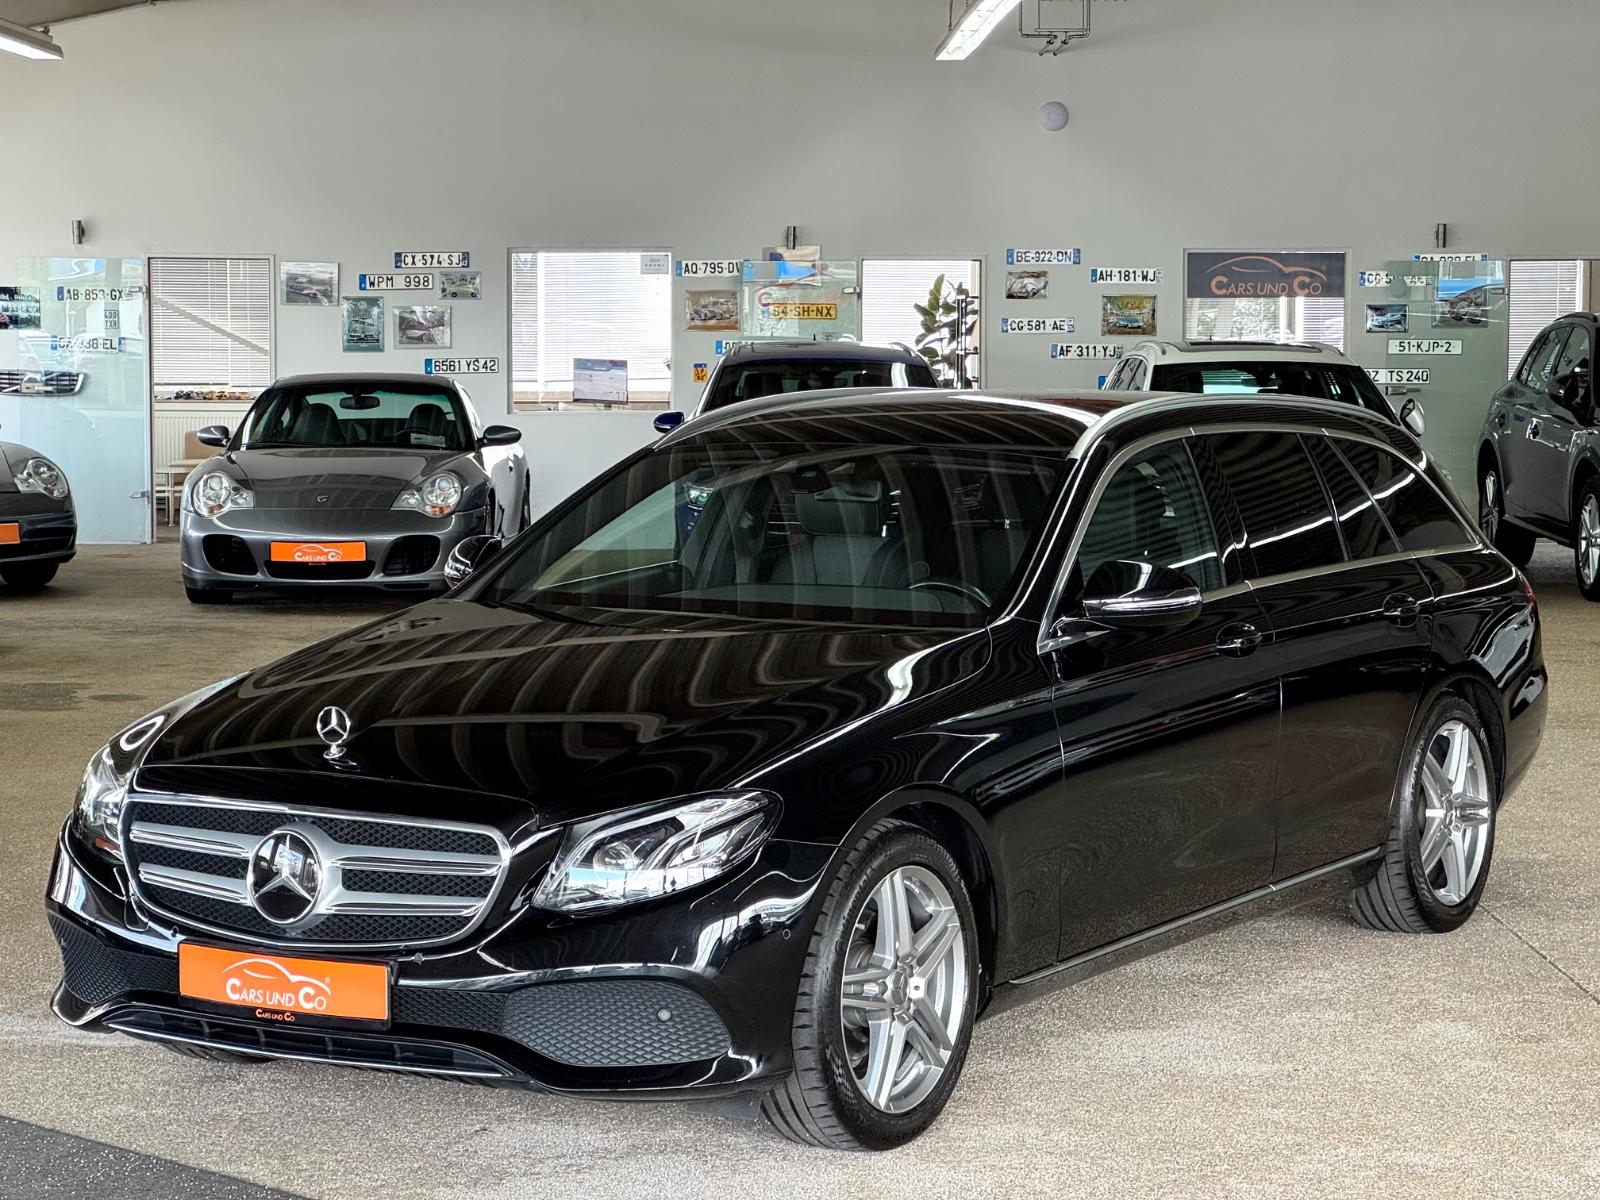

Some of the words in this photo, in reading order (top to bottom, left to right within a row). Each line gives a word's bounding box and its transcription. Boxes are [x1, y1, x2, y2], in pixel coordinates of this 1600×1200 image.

[368, 275, 394, 288] WPM
[404, 275, 430, 288] 998
[1098, 269, 1156, 282] AH-181-WJ
[1210, 275, 1253, 295] CARS
[1257, 283, 1288, 295] UND
[1293, 275, 1322, 295] CO
[434, 359, 462, 373] 6561
[466, 359, 480, 372] YS
[482, 359, 496, 372] 42
[1388, 370, 1403, 382] TS
[1406, 370, 1429, 382] 240
[225, 977, 263, 1004] CARS
[266, 991, 295, 1007] UND
[298, 986, 327, 1010] CO
